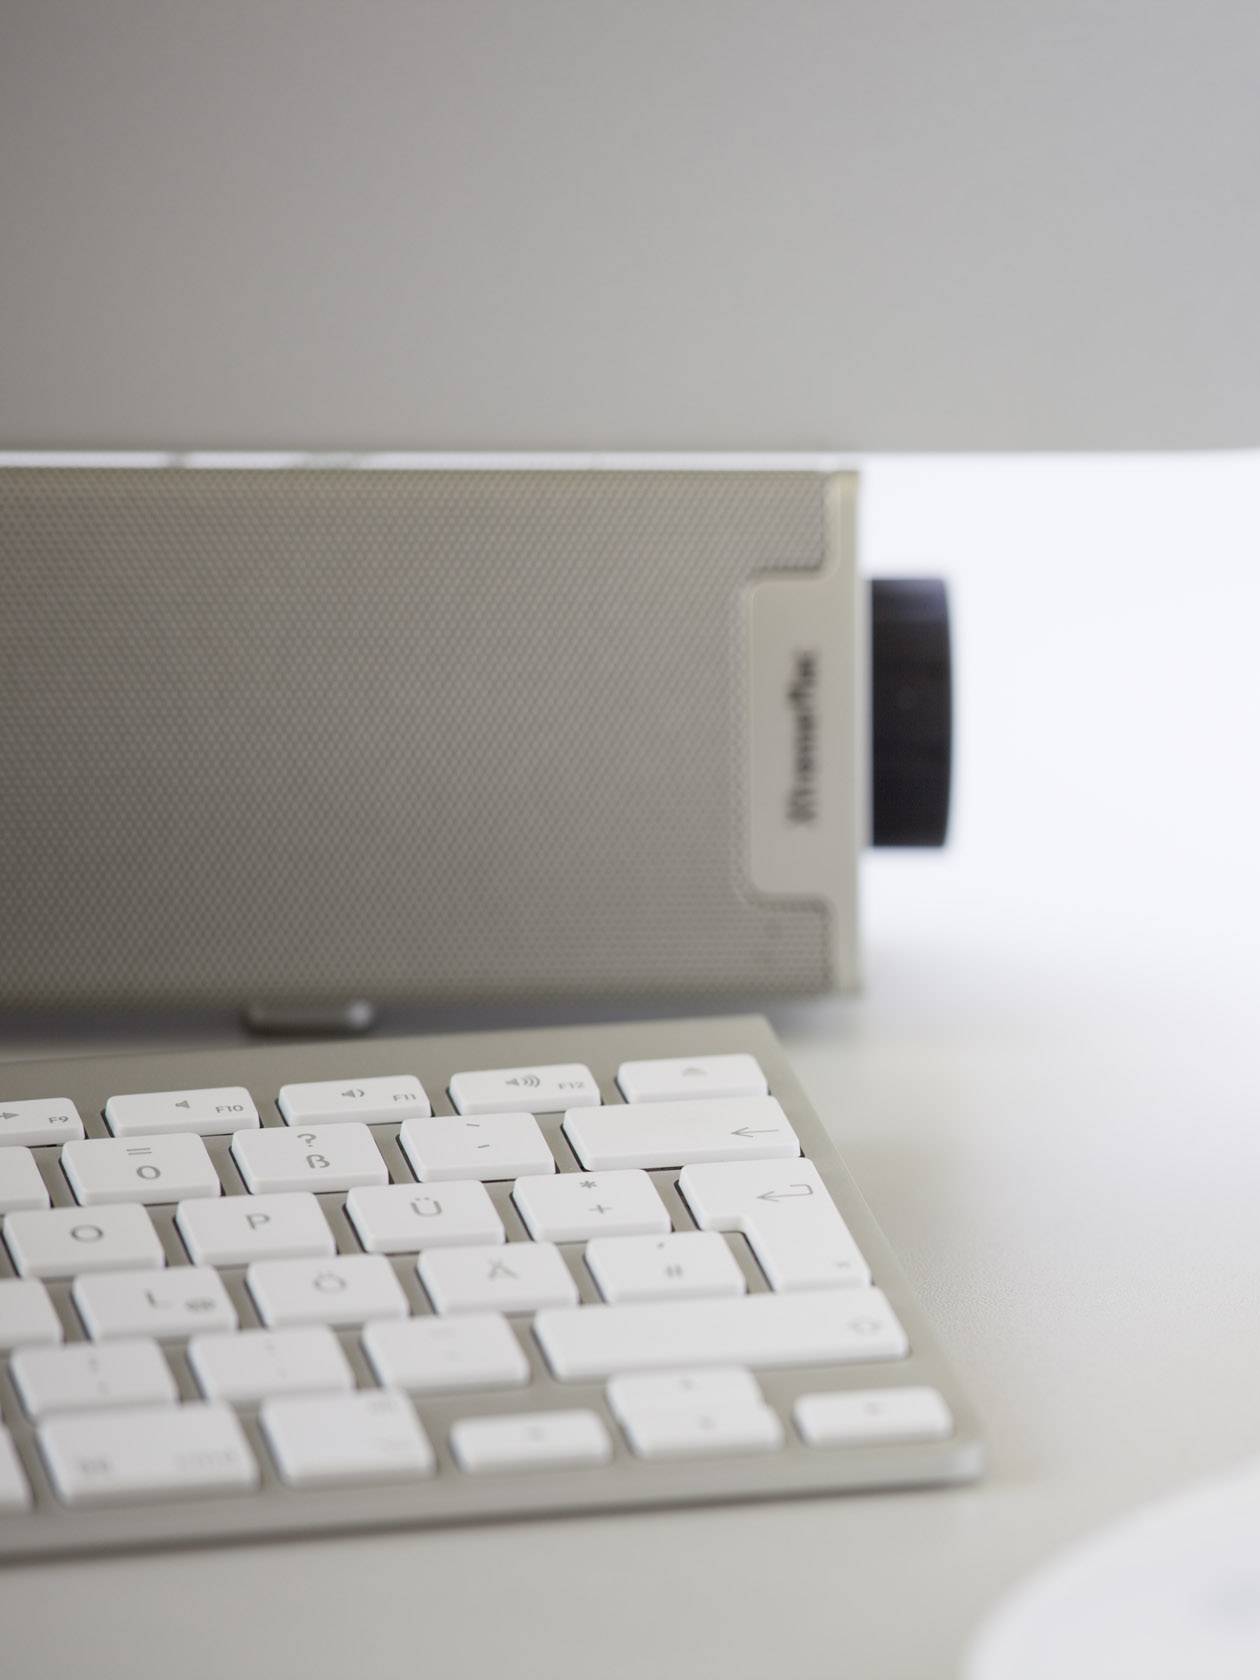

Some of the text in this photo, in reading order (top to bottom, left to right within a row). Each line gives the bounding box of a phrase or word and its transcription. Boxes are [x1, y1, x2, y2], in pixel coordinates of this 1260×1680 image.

[215, 1104, 244, 1114] F10
[48, 1114, 69, 1124] F9
[246, 1213, 270, 1230] P
